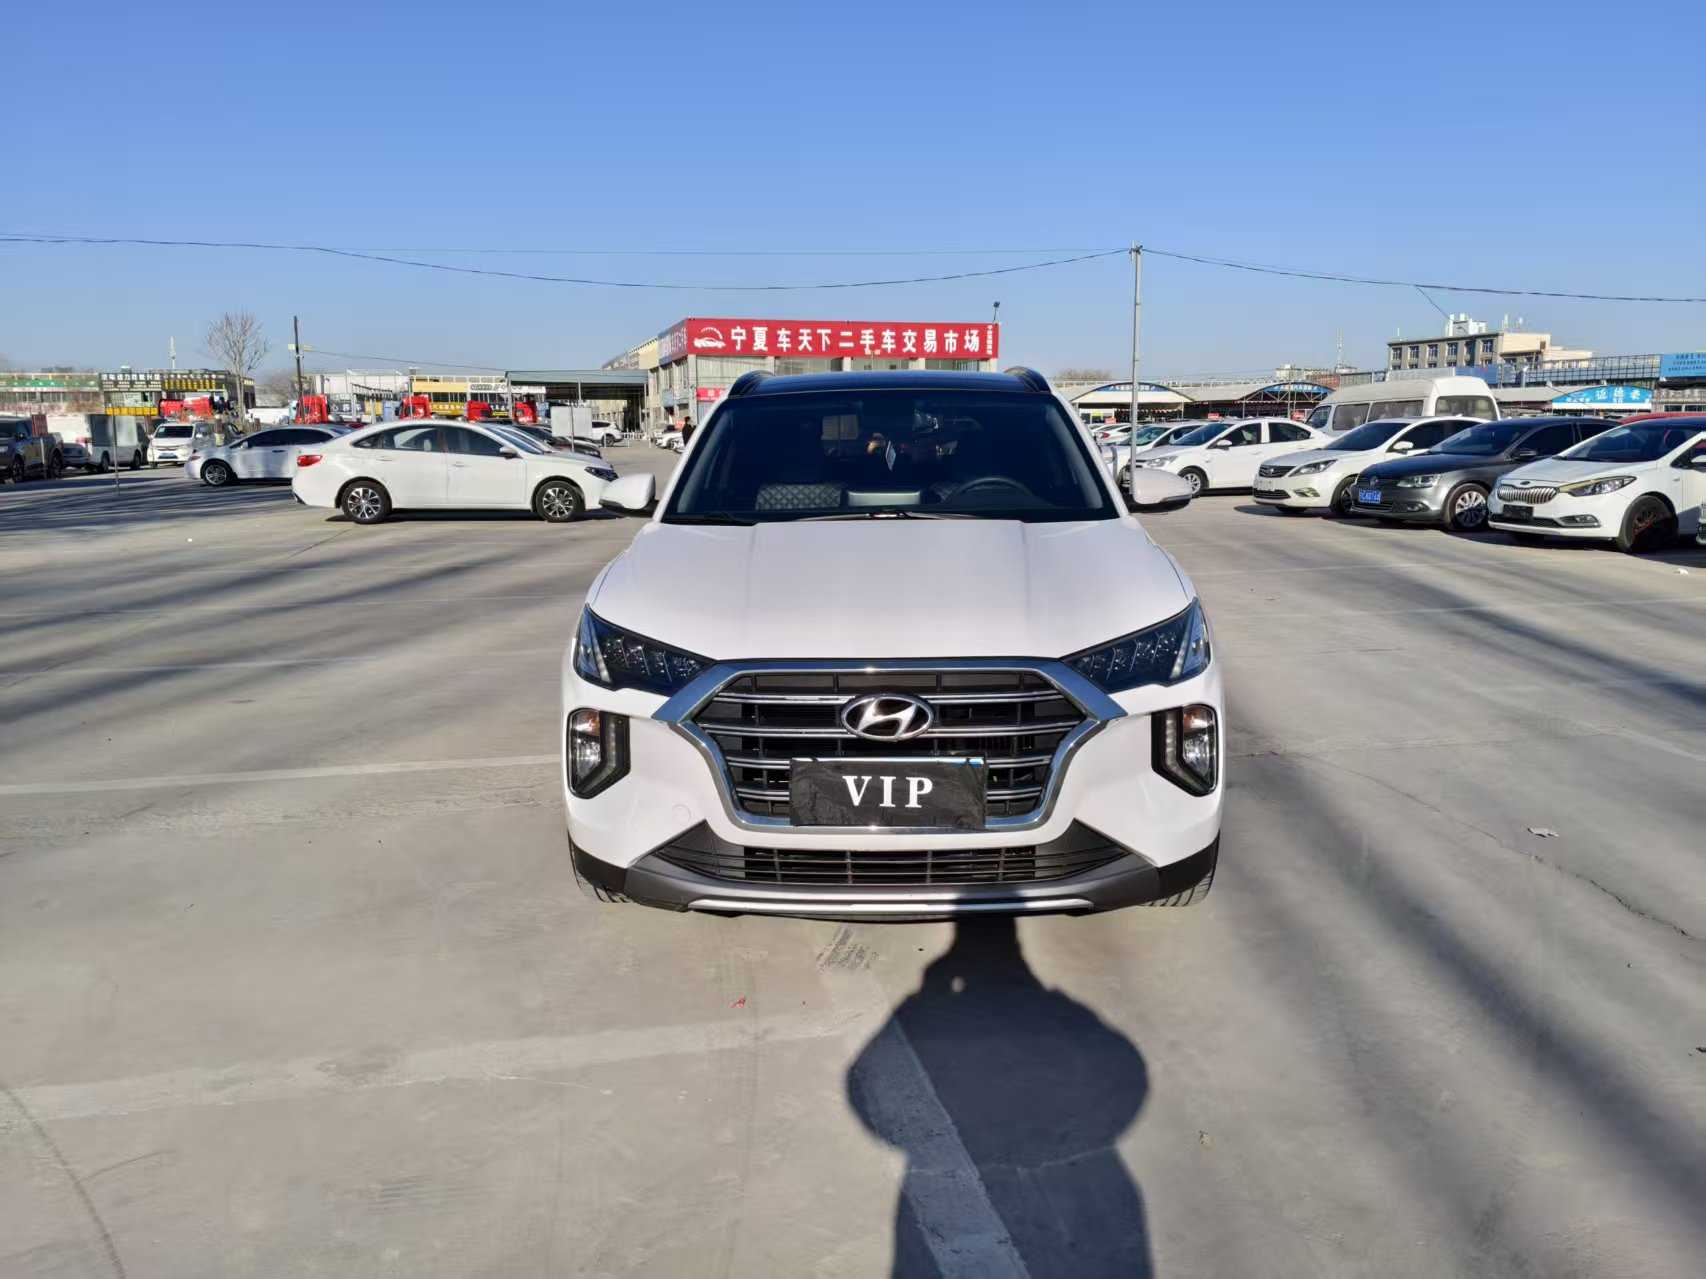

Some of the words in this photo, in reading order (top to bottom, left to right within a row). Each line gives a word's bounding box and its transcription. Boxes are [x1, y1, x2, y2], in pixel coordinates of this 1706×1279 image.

[730, 326, 980, 354] 宁夏车天下二手车交易市场
[842, 776, 933, 808] VIP
